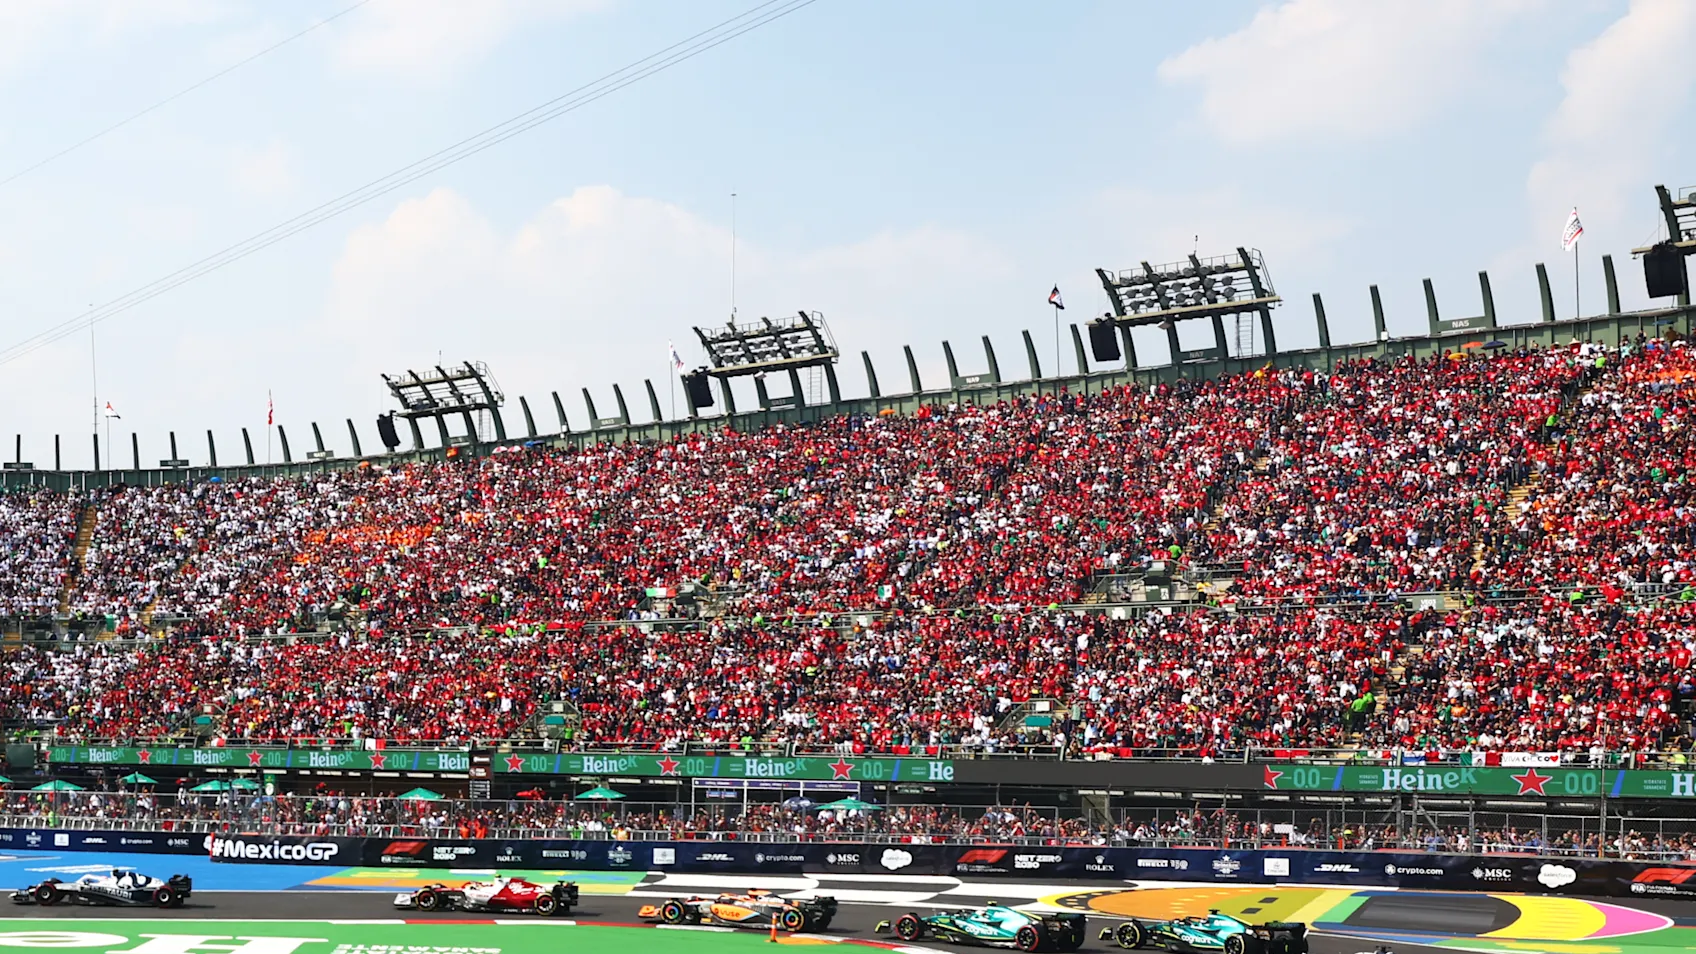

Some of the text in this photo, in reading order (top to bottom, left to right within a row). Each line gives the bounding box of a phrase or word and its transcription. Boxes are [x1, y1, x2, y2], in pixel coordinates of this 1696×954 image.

[1452, 320, 1469, 328] NA5
[1189, 351, 1204, 359] NA7
[686, 759, 704, 775] 0.0
[862, 761, 883, 779] 0.0
[1293, 768, 1320, 788] 0.0
[1565, 772, 1596, 794] 0.0
[212, 838, 338, 861] #MexicoGP
[766, 854, 804, 863] crypto.com
[837, 854, 860, 862] MSC
[1014, 854, 1035, 862] NET
[1014, 861, 1040, 869] 2030
[1137, 859, 1168, 867] PIRELLI
[1397, 867, 1444, 876] crypto.com
[1484, 868, 1512, 878] MSC
[1630, 883, 1646, 893] FIA
